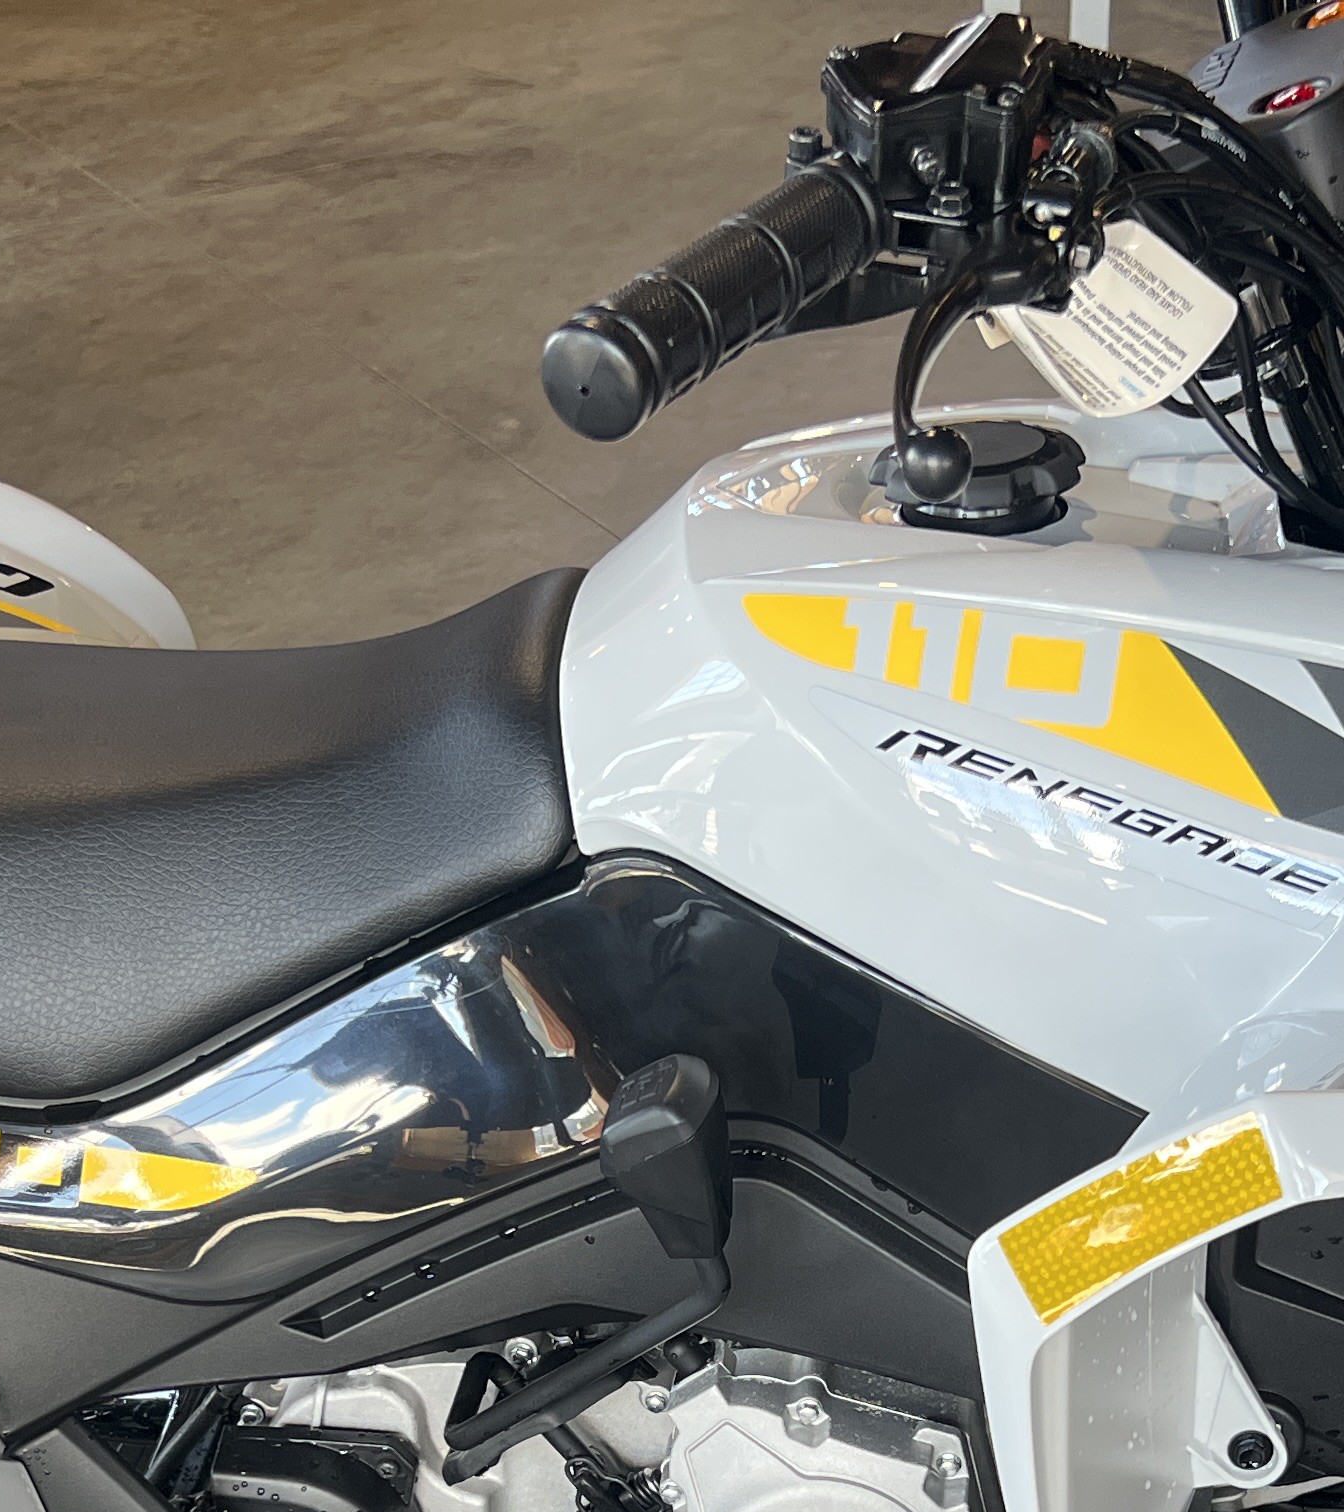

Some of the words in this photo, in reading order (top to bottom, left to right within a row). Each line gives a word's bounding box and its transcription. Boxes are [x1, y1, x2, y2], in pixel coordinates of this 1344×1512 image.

[1129, 274, 1148, 292] READ
[1145, 287, 1161, 303] AND
[1156, 280, 1169, 293] ALL
[1158, 297, 1183, 321] LOCATE
[1167, 289, 1193, 313] FOLLOW
[844, 595, 1122, 728] 110
[875, 728, 1341, 899] RENEGADE
